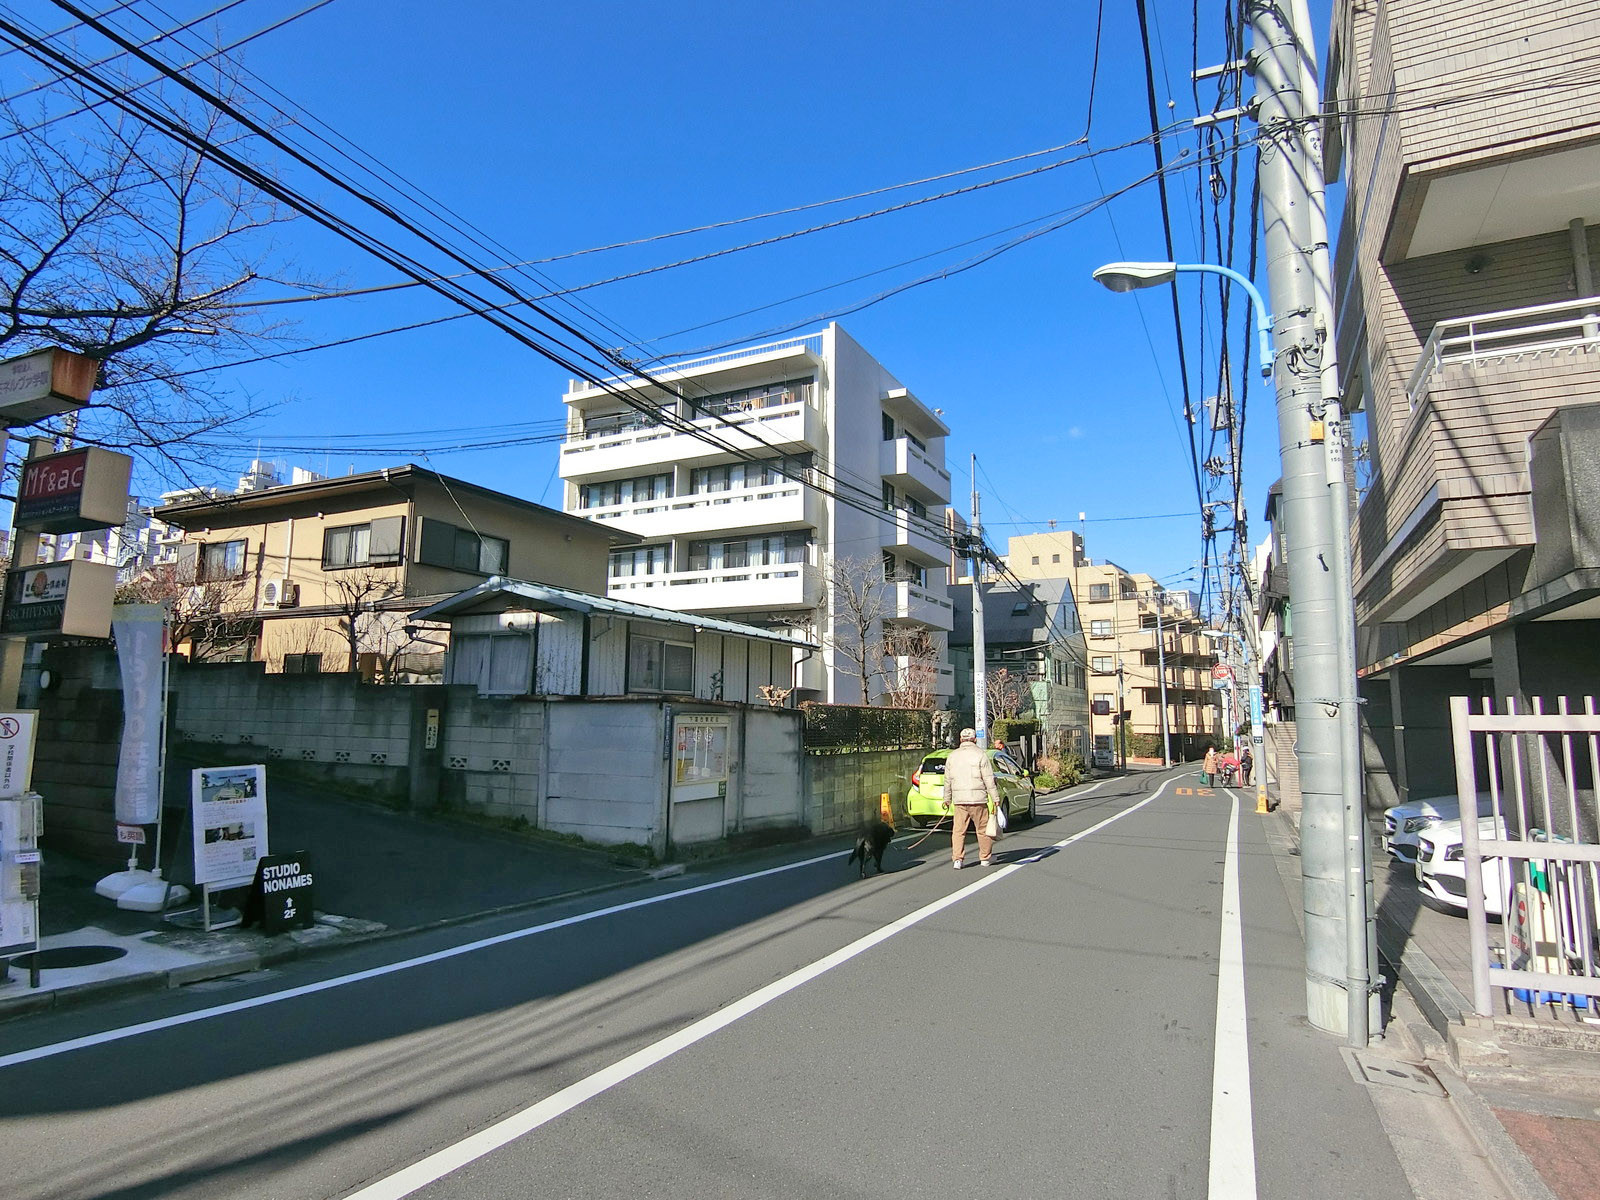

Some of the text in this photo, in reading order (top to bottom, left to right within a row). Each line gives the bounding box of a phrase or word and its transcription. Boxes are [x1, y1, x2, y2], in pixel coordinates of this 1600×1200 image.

[263, 862, 300, 880] STUDIO
[263, 873, 313, 894] NONAMES
[283, 908, 297, 919] 2F
